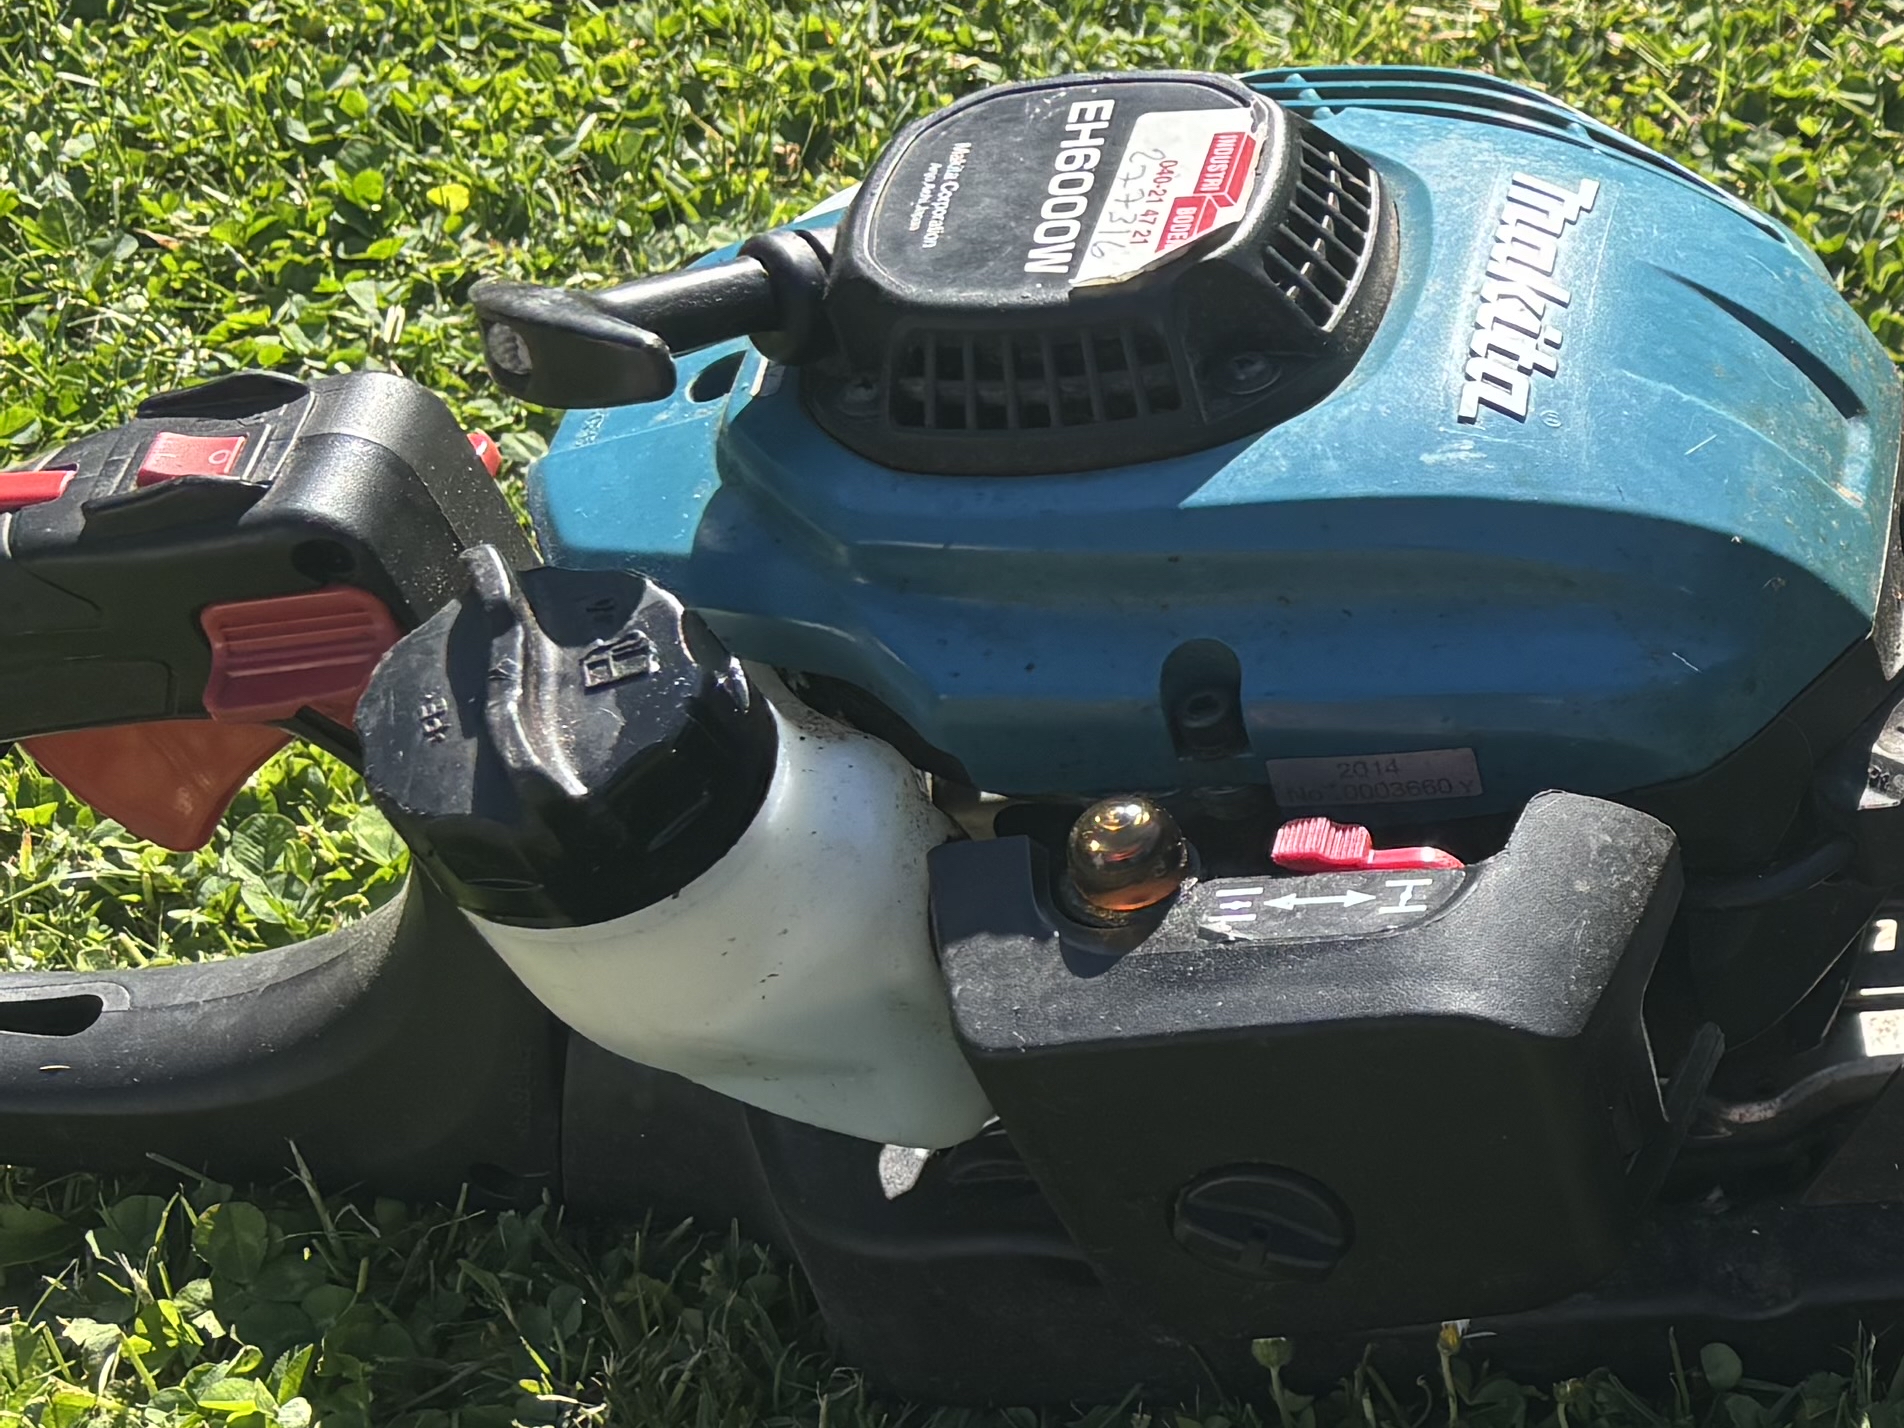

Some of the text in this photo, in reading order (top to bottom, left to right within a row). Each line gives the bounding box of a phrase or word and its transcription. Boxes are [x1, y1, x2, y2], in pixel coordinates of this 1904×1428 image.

[922, 142, 972, 248] Makita Corporation
[1023, 99, 1115, 275] EH6000W
[1089, 148, 1166, 260] 277316
[1130, 159, 1178, 245] 040-21 47 21
[1198, 134, 1238, 192] INDUSTRI
[1336, 758, 1401, 779] 2014
